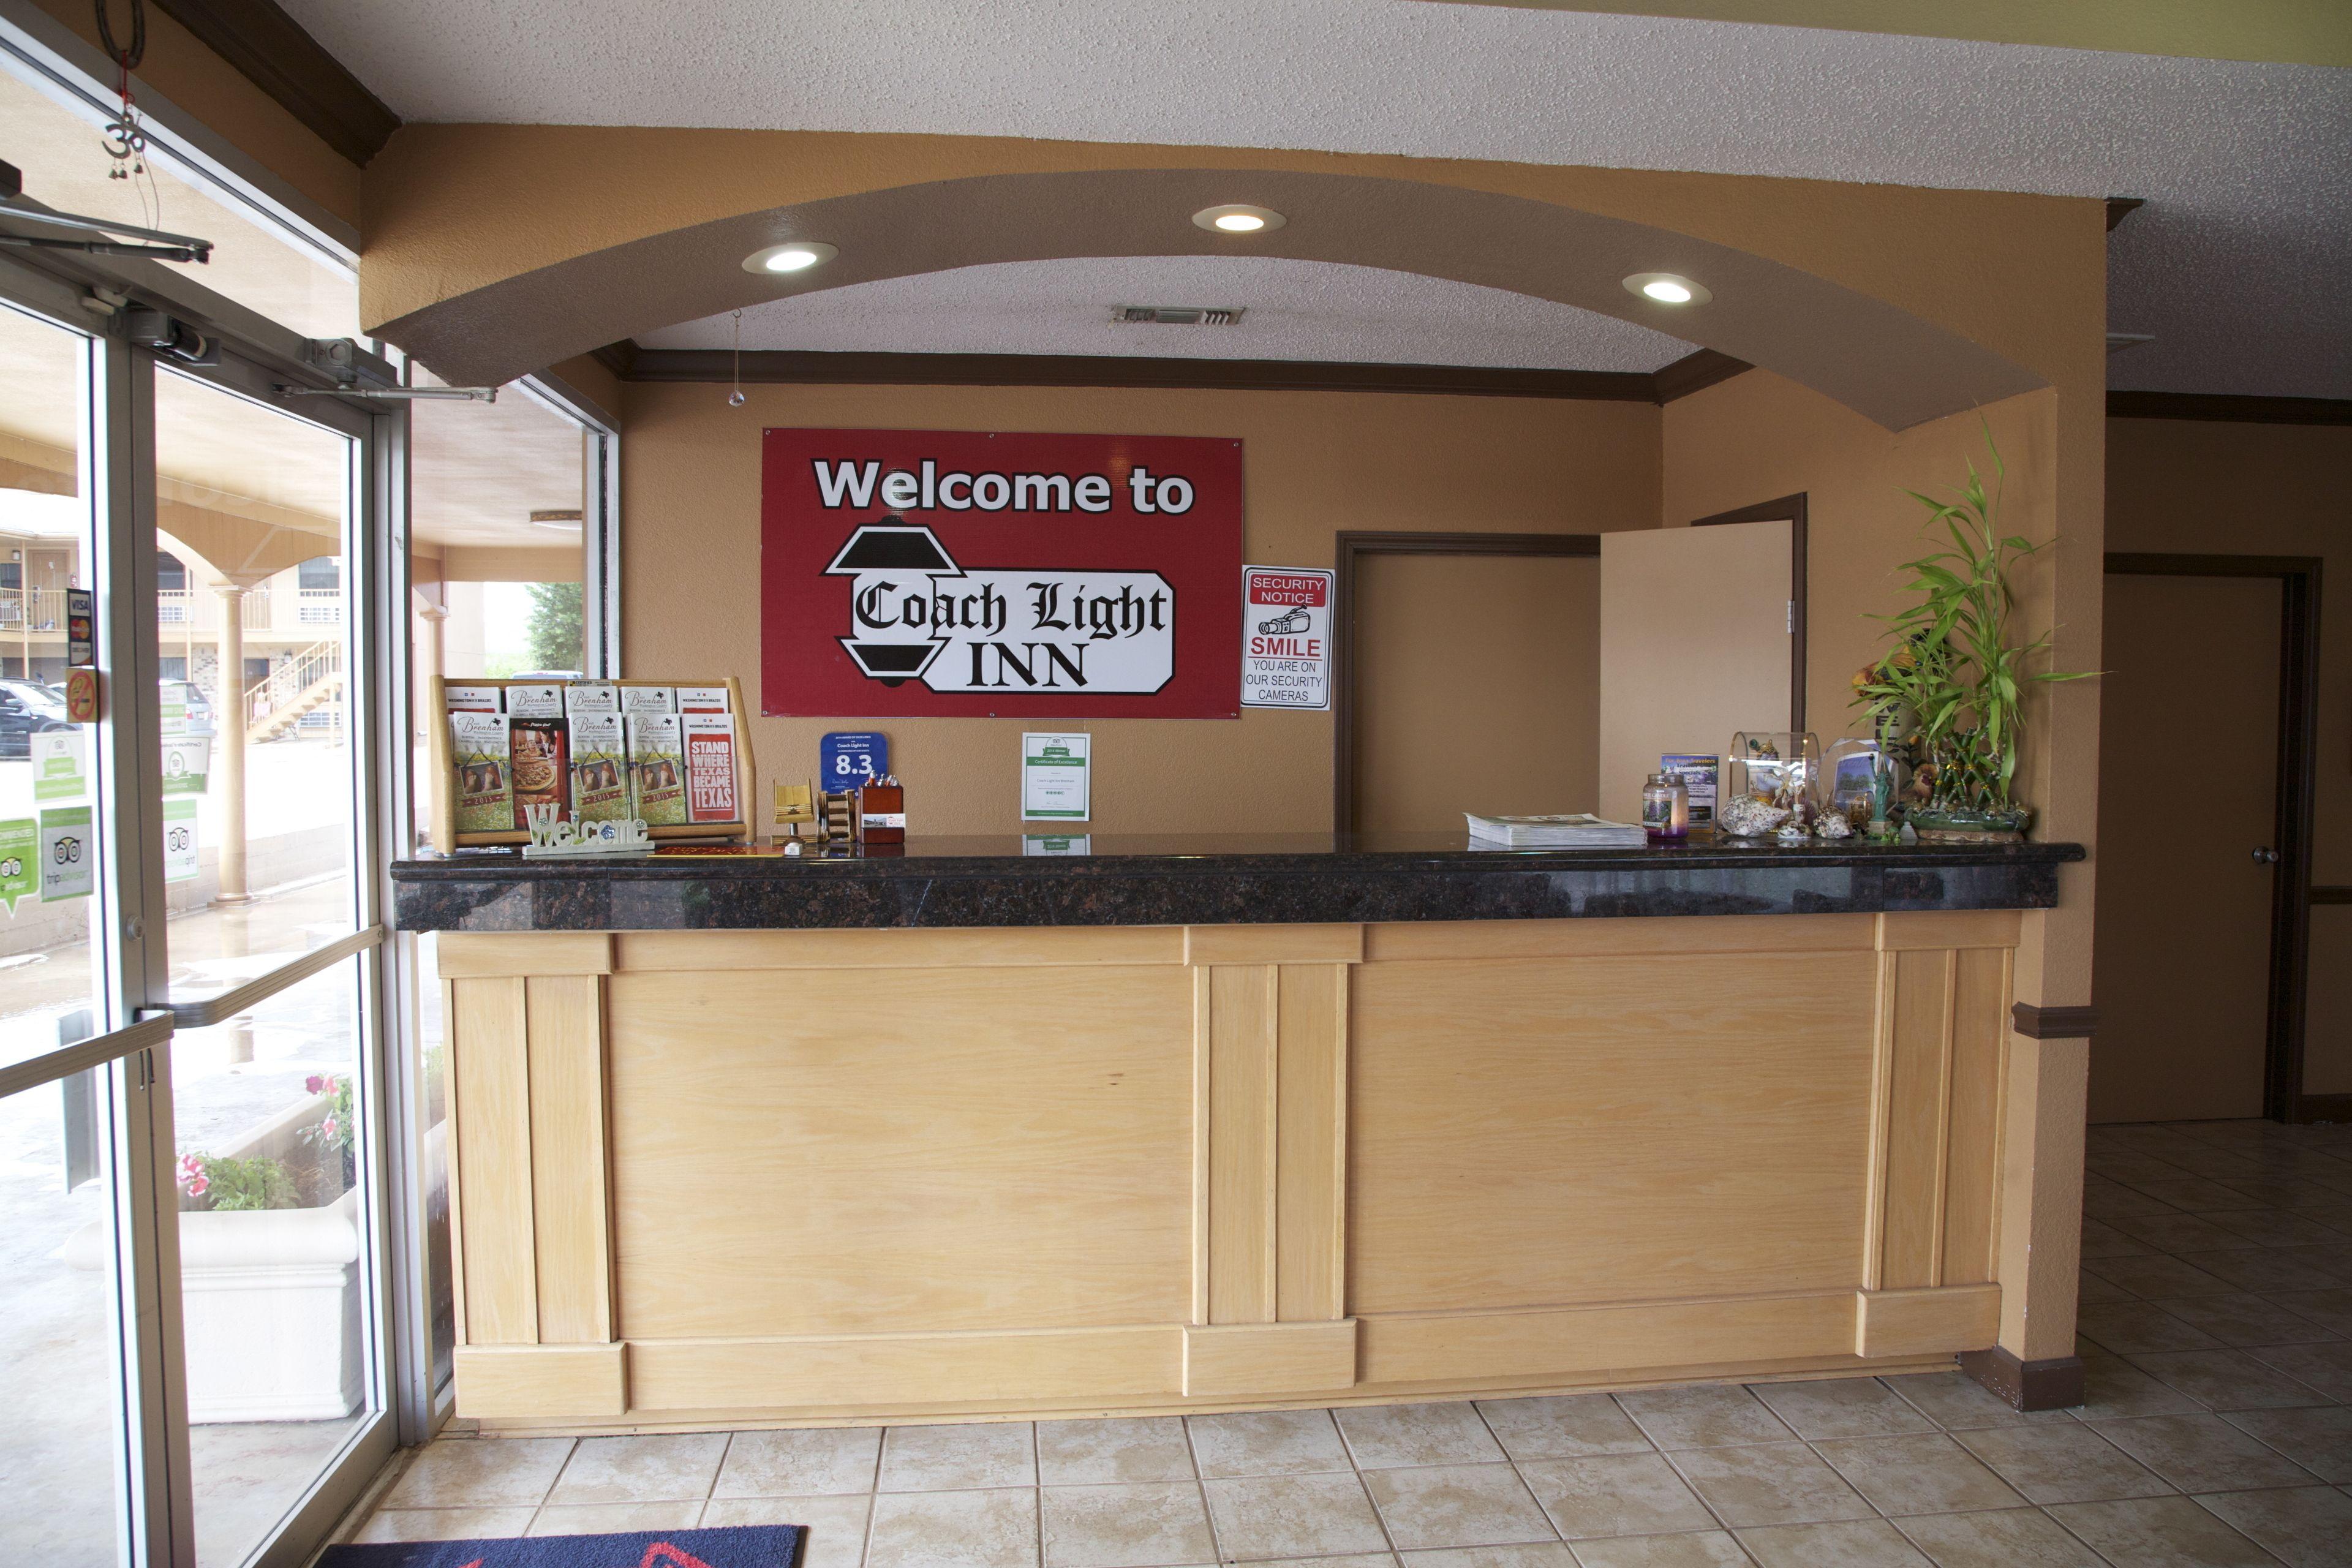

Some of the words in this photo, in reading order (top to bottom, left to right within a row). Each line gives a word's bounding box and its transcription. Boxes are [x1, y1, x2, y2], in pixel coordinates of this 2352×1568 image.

[812, 459, 1112, 512] Welcome
[1130, 467, 1195, 515] to
[1253, 578, 1324, 591] SECURITY
[1261, 591, 1314, 603] NOTICE
[72, 600, 89, 610] VISA
[856, 581, 1006, 637] Coach
[1027, 583, 1167, 640] Light
[1251, 636, 1321, 657] SMILE
[967, 642, 1090, 687] INN
[1253, 660, 1275, 671] YOU
[1278, 661, 1298, 672] ARE
[1301, 662, 1316, 673] ON
[1246, 674, 1268, 685] OUR
[1271, 675, 1322, 687] SECURITY
[511, 690, 556, 706] Brenham
[568, 690, 612, 706] Brenham
[625, 691, 666, 706] Brenham
[1258, 689, 1308, 701] CAMERAS
[458, 716, 503, 733] Brenham
[573, 716, 616, 733] Brenham
[635, 717, 675, 733] Brenham
[692, 741, 729, 754] STAND
[692, 754, 729, 767] WHERE
[836, 754, 873, 775] 8.3
[693, 775, 731, 788] BECAME
[594, 793, 609, 802] 2015
[653, 792, 669, 801] 2015
[693, 788, 733, 808] TEXAS
[524, 803, 648, 848] Welcome
